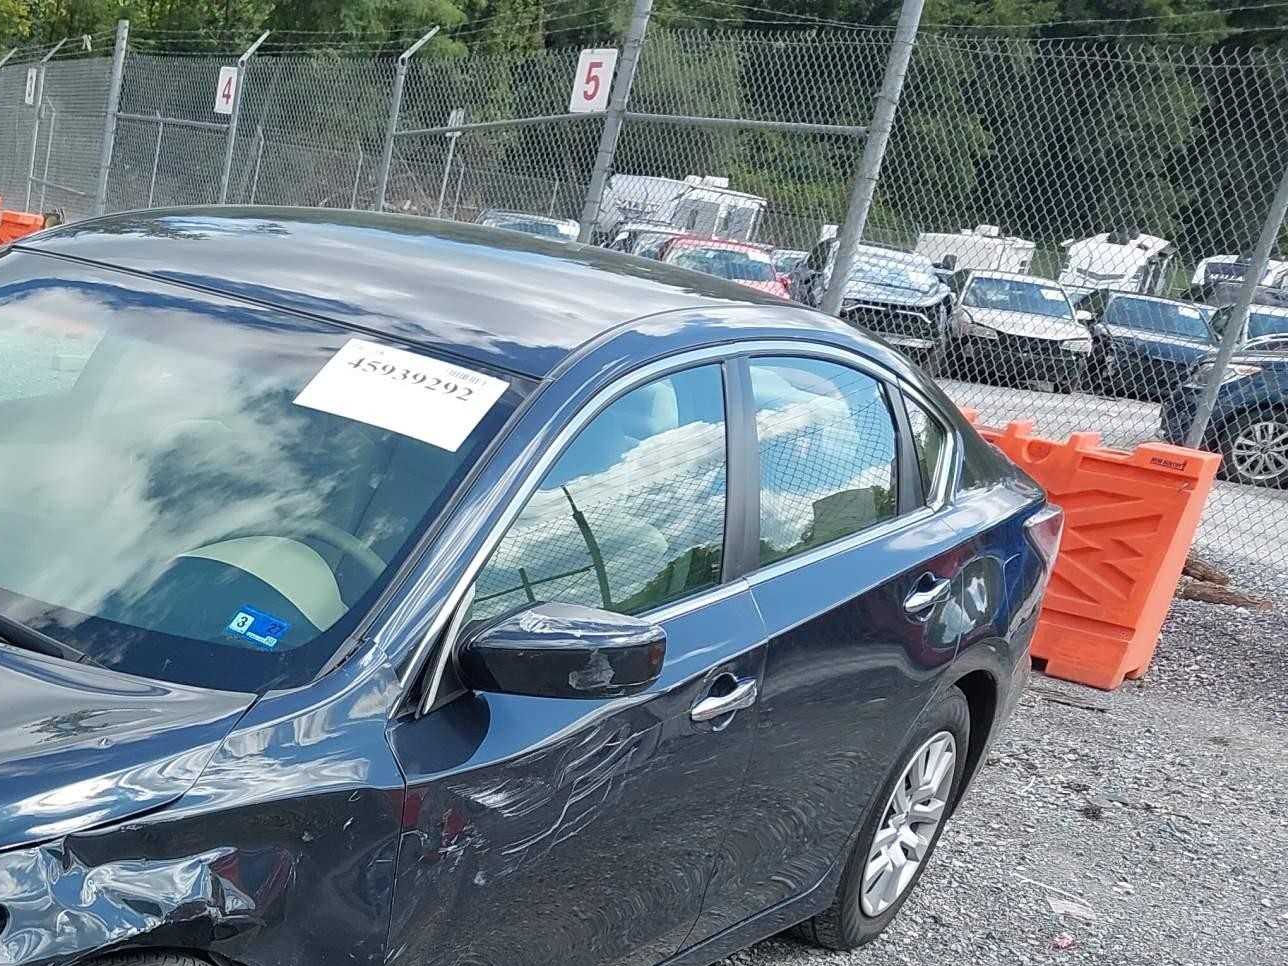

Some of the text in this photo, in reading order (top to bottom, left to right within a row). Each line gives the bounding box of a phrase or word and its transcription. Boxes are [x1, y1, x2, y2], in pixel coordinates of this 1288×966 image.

[222, 76, 233, 105] 4
[583, 61, 604, 102] 5
[347, 357, 474, 402] 45939292
[237, 616, 249, 628] 3
